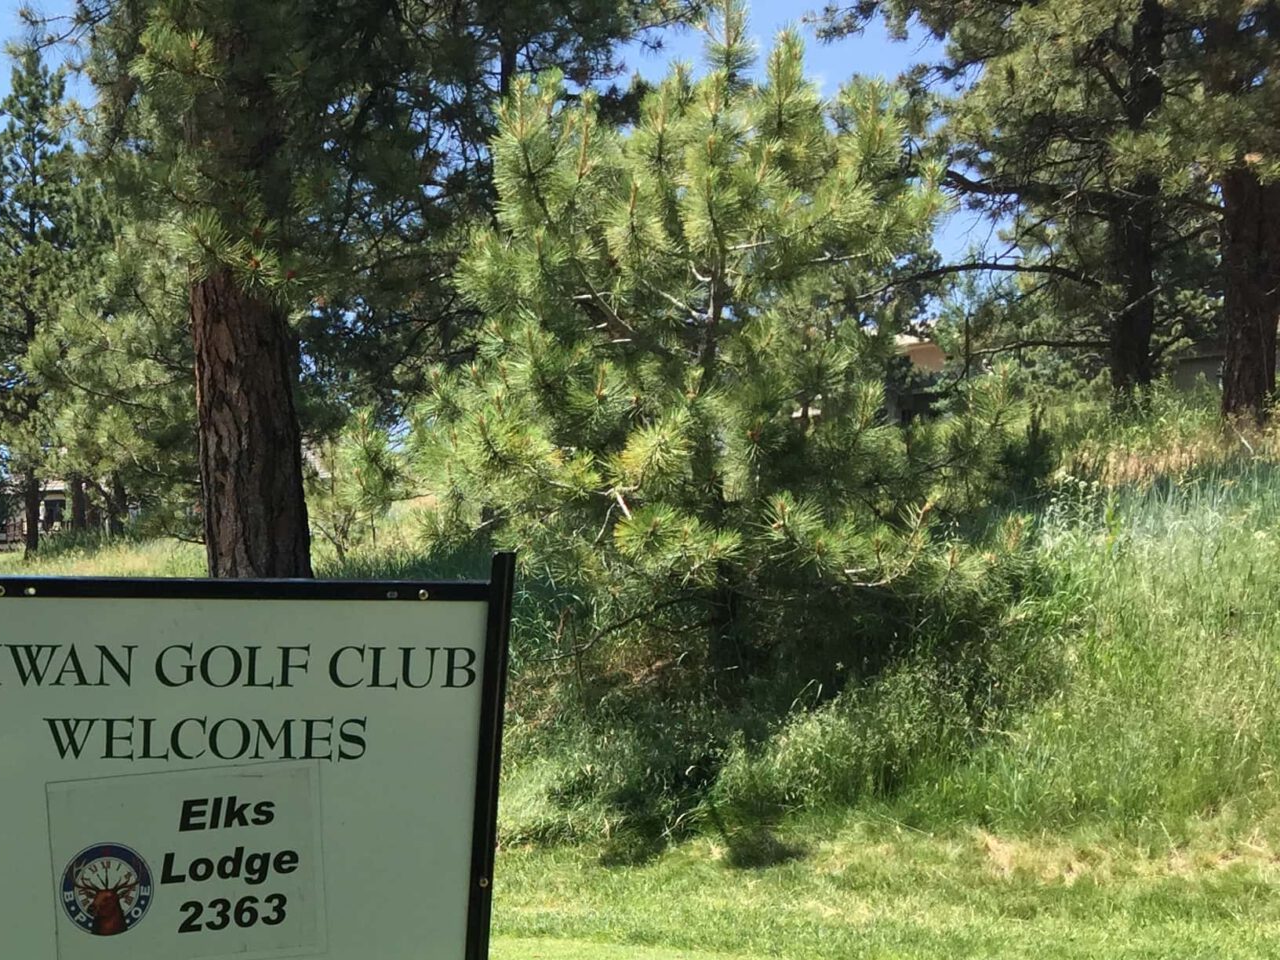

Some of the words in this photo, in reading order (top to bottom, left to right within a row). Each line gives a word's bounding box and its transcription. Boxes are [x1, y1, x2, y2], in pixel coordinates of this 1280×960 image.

[156, 643, 310, 689] GOLF
[329, 645, 476, 689] CLUB
[43, 717, 367, 760] WELCOMES
[179, 796, 275, 832] Elks
[161, 847, 298, 885] Lodge
[178, 894, 287, 933] 2363
